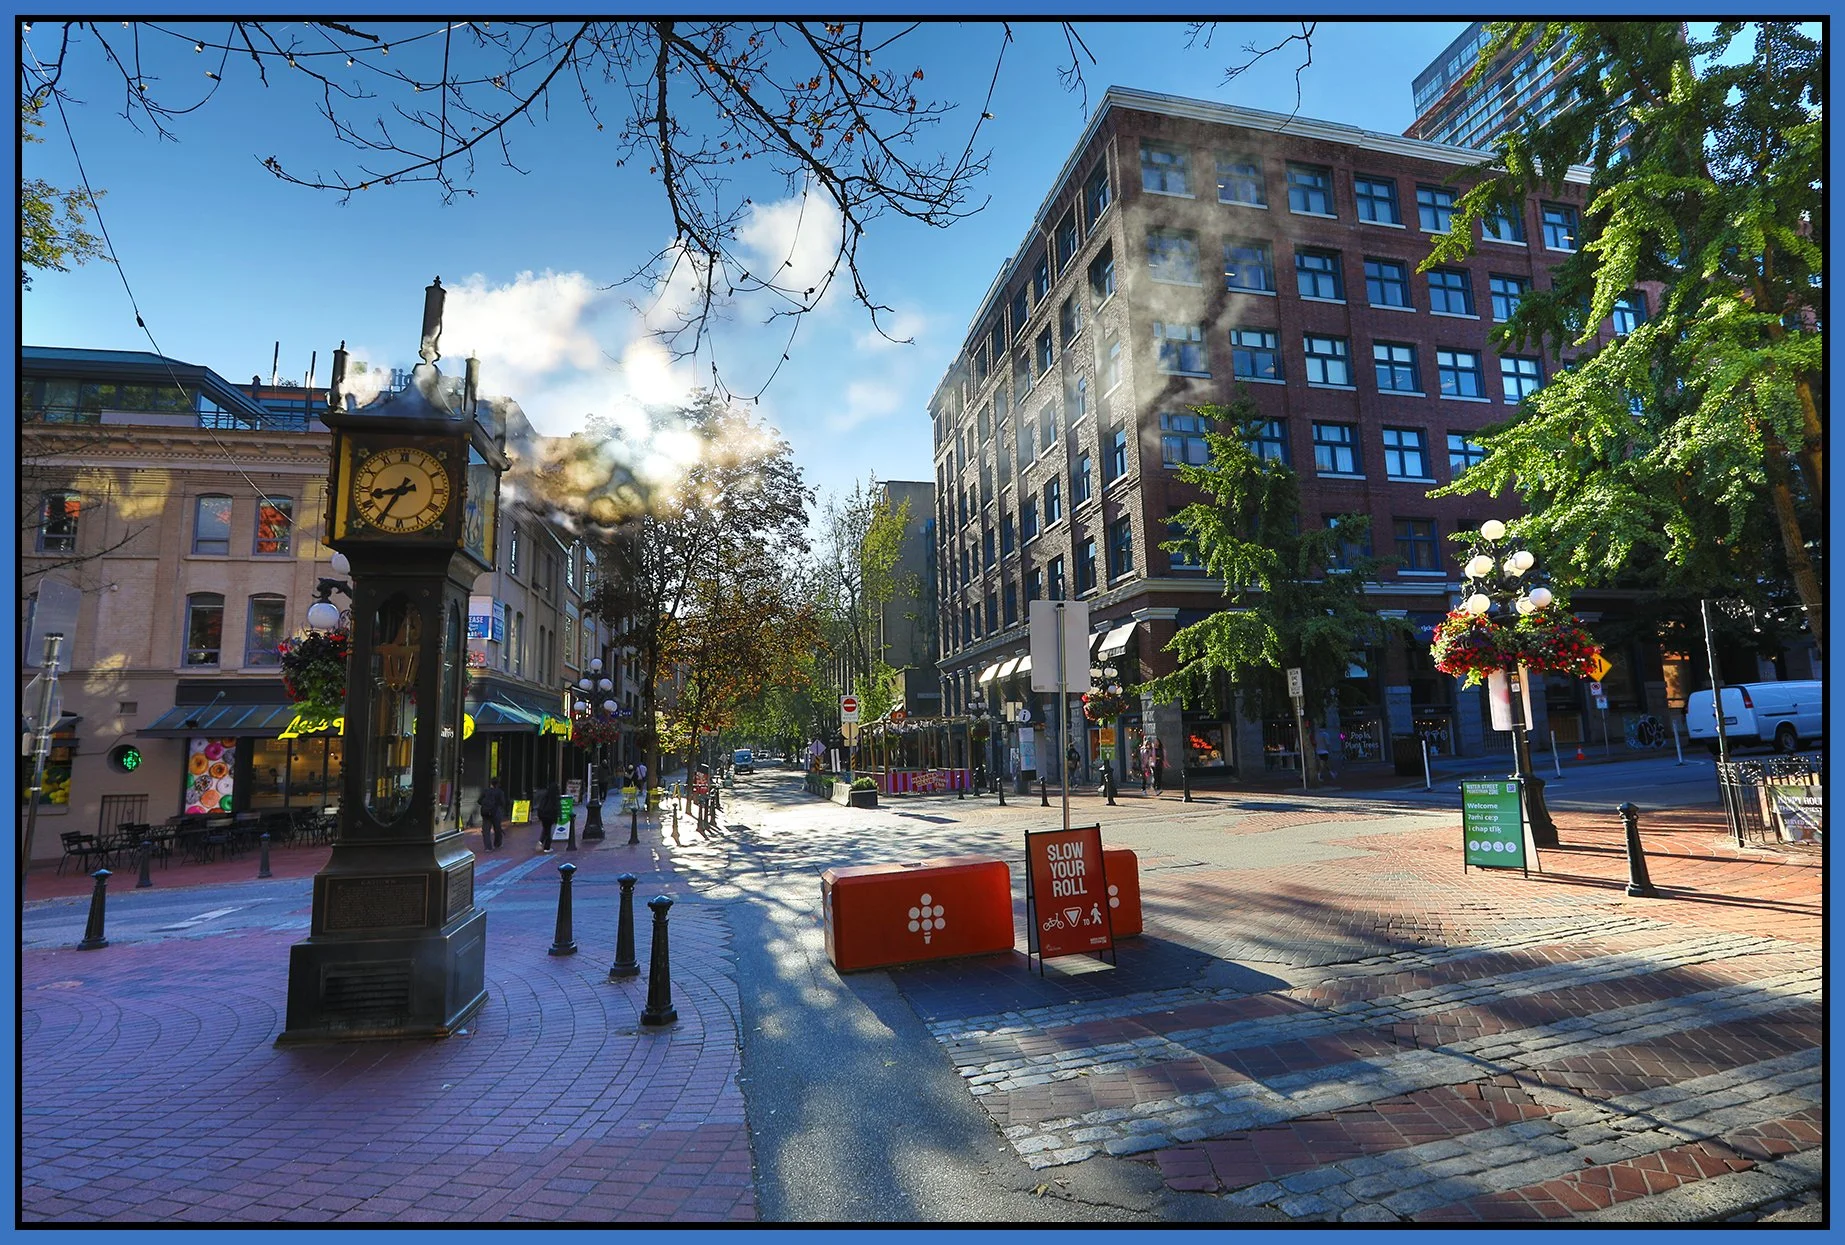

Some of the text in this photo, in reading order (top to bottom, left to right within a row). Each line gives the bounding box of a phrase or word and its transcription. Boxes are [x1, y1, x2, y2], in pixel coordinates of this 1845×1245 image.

[1047, 842, 1084, 861] SLOW
[1049, 860, 1086, 879] YOUR
[1053, 878, 1088, 897] ROLL
